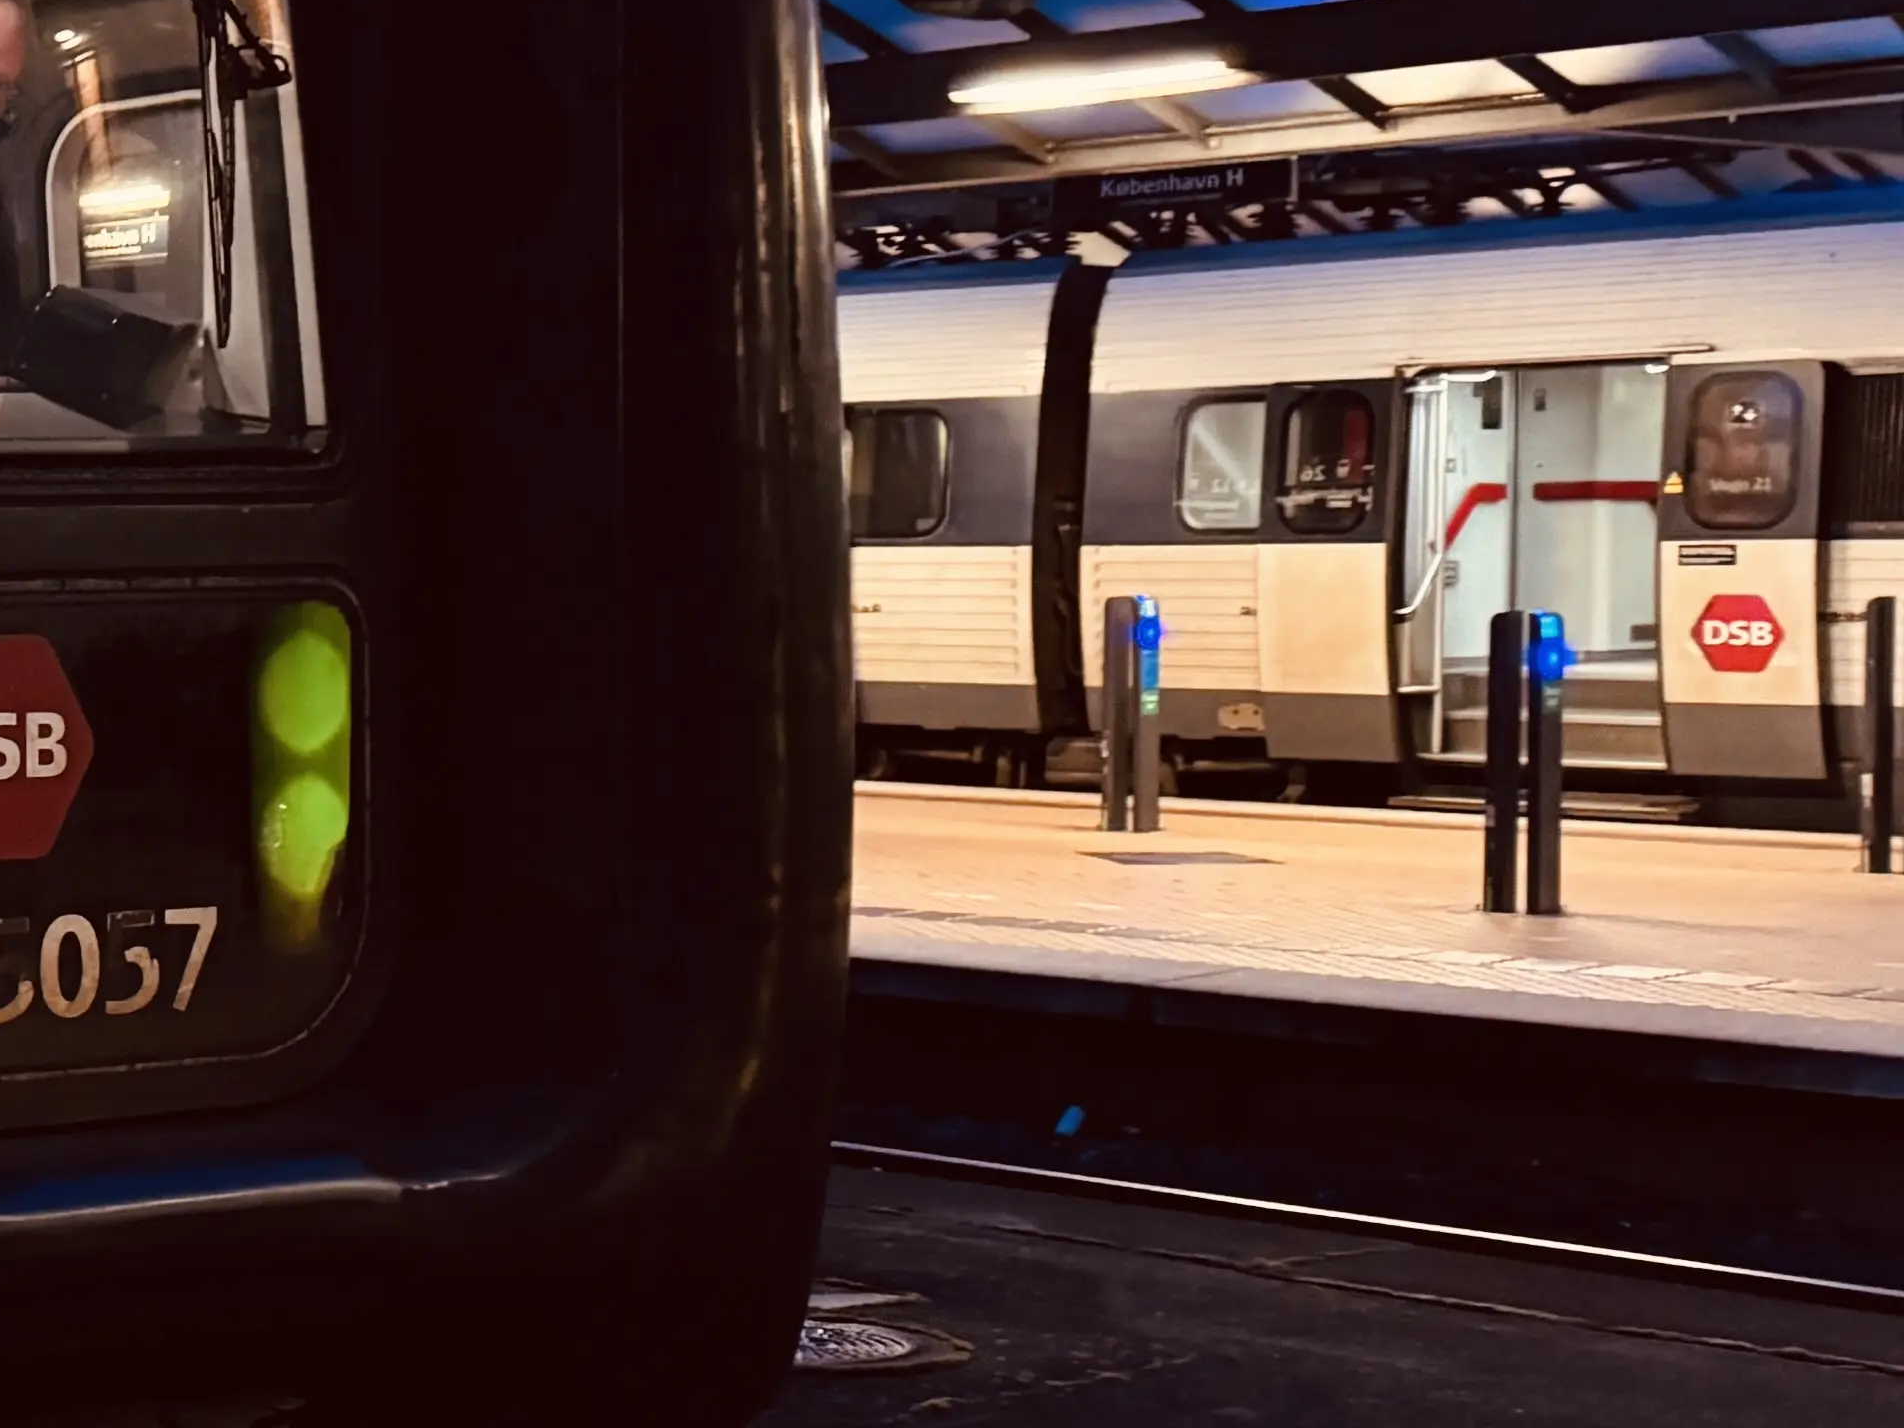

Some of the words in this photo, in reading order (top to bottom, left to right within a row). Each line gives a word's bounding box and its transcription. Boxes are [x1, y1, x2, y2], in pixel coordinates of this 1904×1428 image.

[1100, 174, 1219, 198] København
[1226, 167, 1244, 188] H
[1702, 620, 1774, 646] DSB
